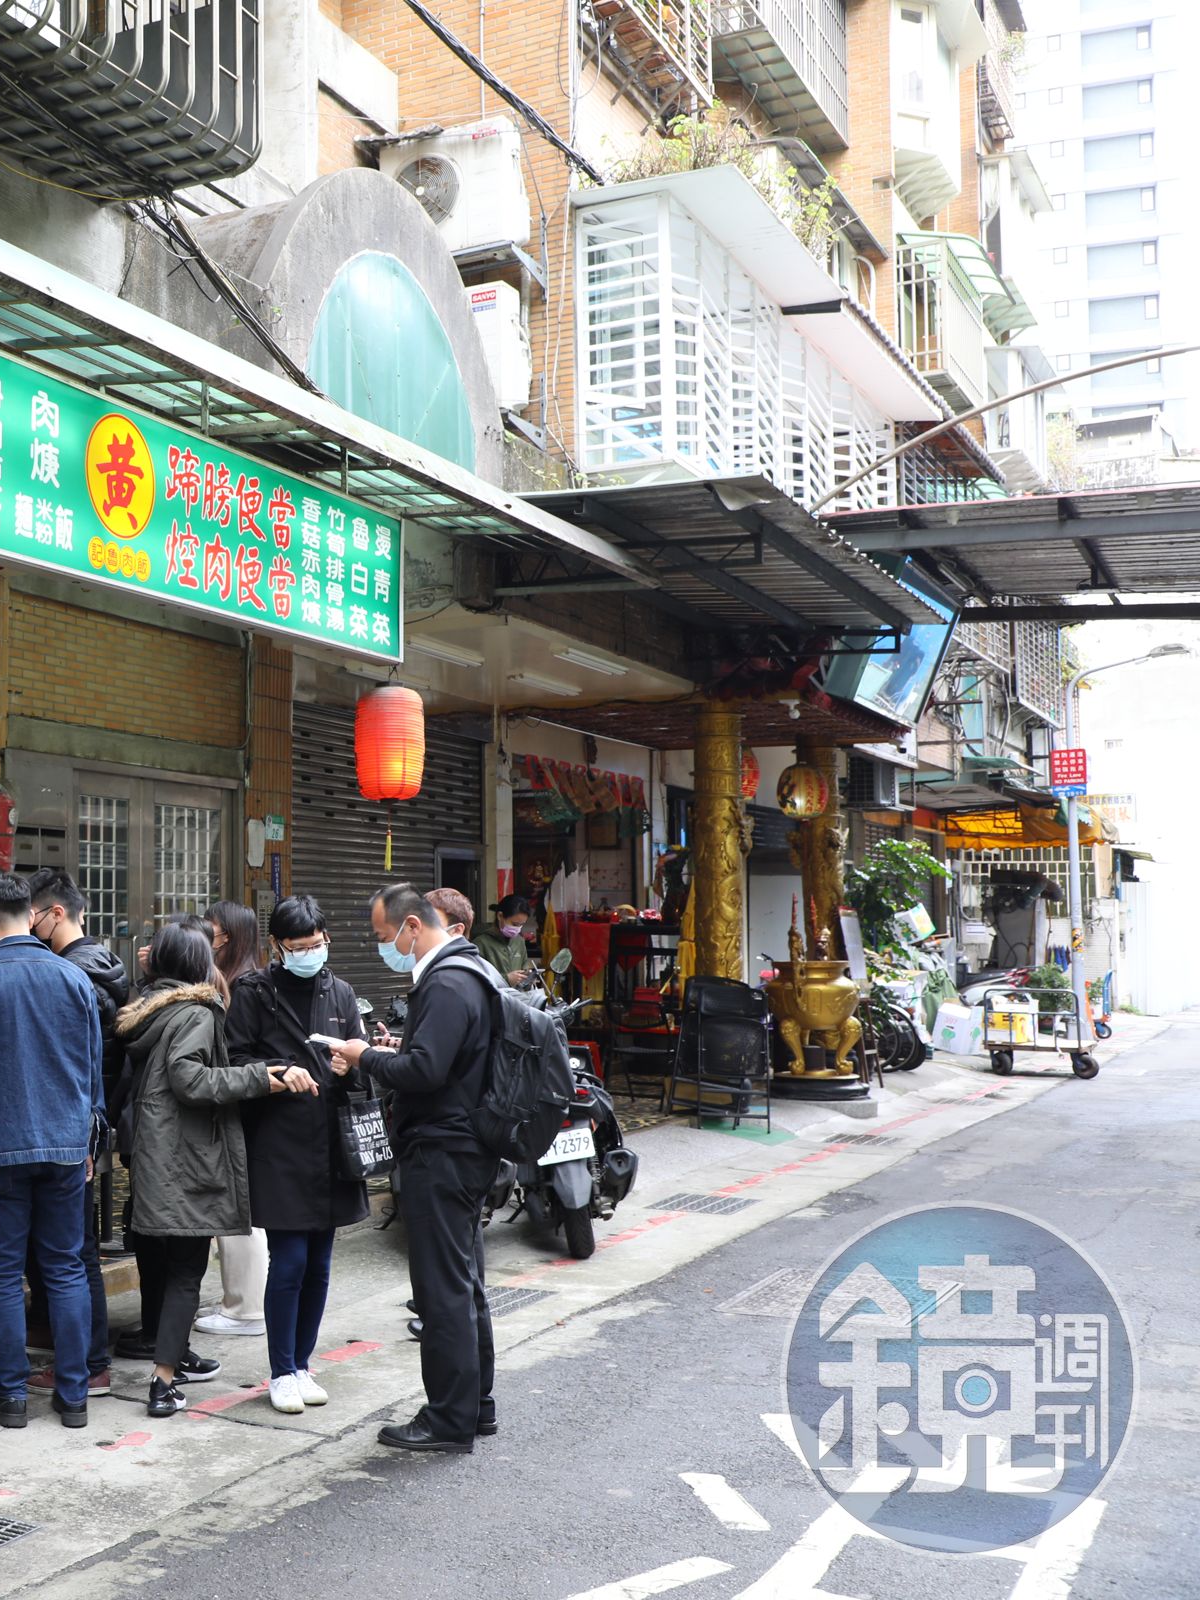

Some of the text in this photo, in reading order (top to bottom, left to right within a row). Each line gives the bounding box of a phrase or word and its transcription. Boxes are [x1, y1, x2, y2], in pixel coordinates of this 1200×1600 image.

[473, 291, 496, 301] SANYO
[96, 433, 144, 530] 黃
[165, 444, 296, 550] 蹄膀便當
[326, 506, 346, 632] 竹筍排骨湯
[349, 517, 369, 640] 魯白菜
[373, 524, 392, 647] 燙青菜
[352, 1120, 384, 1138] TODAY
[382, 1146, 393, 1160] US
